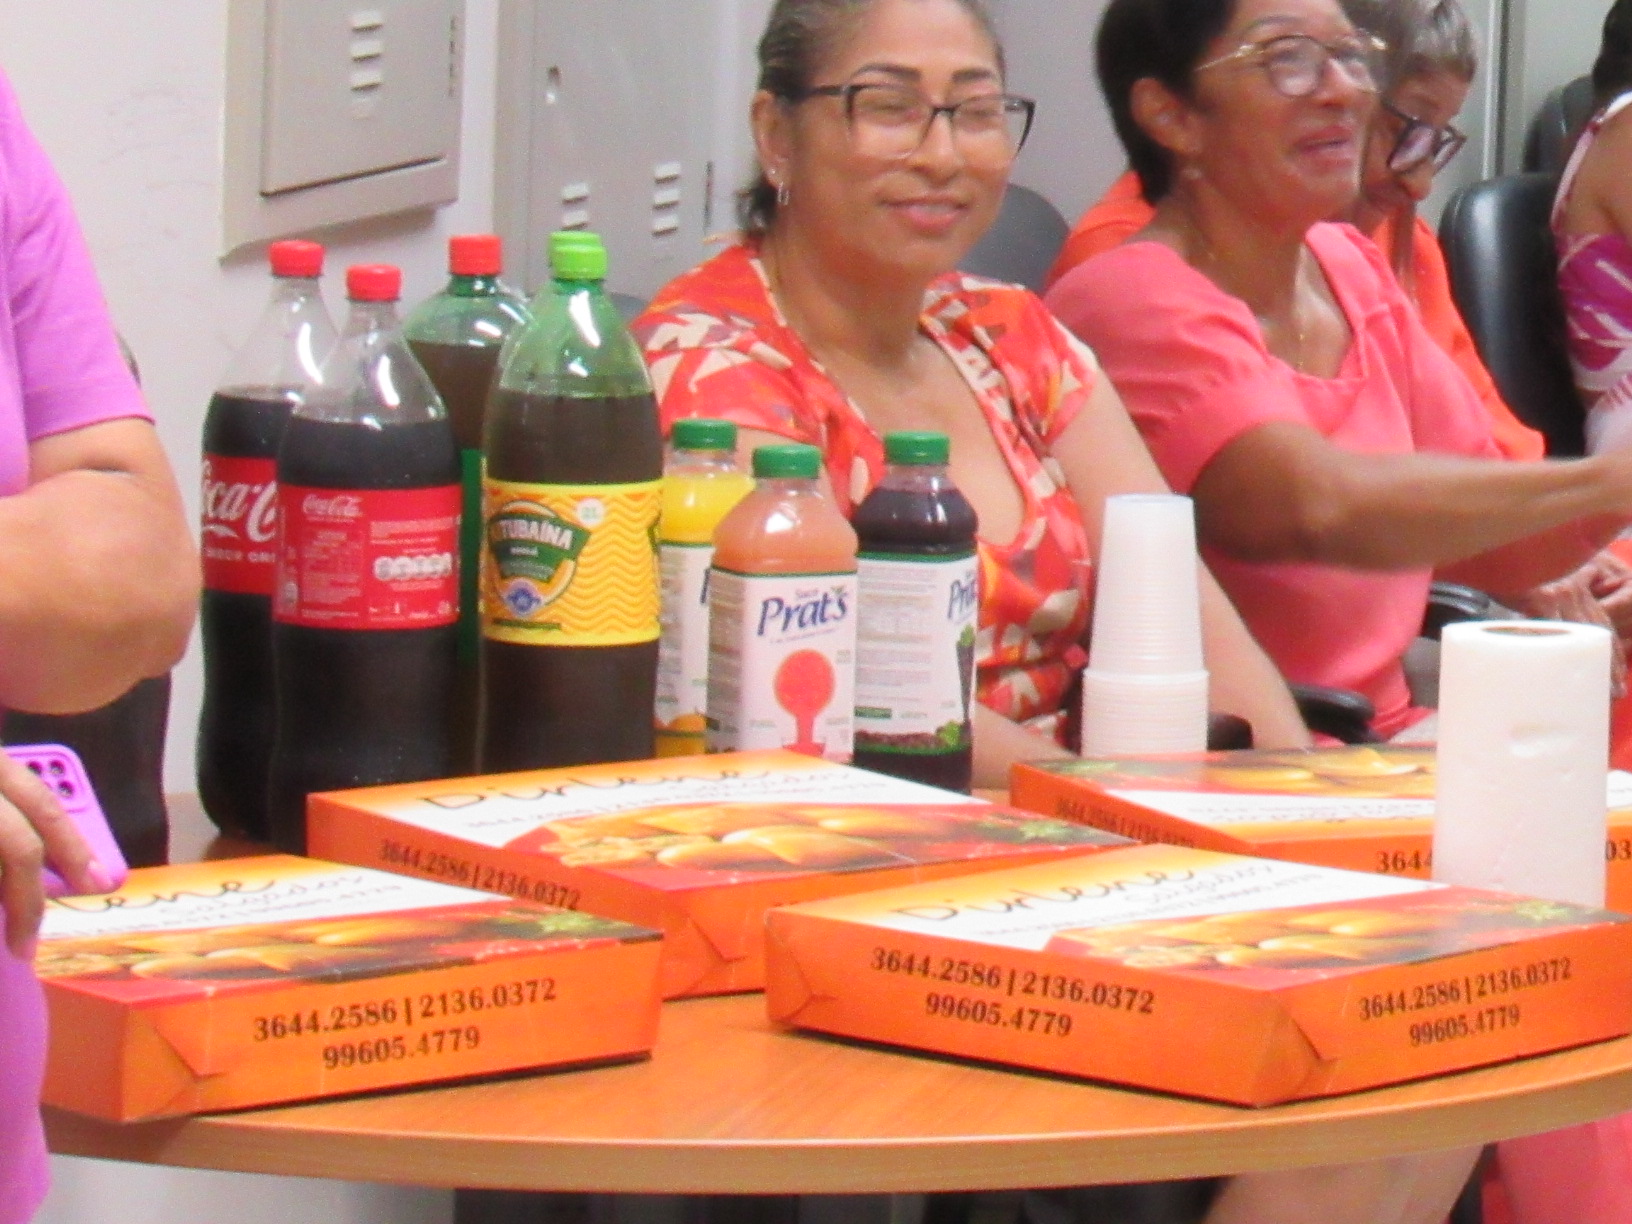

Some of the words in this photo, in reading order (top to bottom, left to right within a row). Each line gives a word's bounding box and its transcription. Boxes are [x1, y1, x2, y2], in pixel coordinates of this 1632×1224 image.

[870, 948, 1001, 989] 3644.2586
[1021, 972, 1155, 1015] 2136.0372
[1358, 982, 1461, 1022] 3644.2586
[1475, 956, 1572, 998] 2136.0372
[253, 1004, 398, 1042] 3644.2586
[419, 977, 557, 1020] 2136.0372
[925, 992, 1073, 1038] 99605.4779
[1408, 1004, 1521, 1047] 99605.4779
[322, 1028, 481, 1070] 99605.4779
